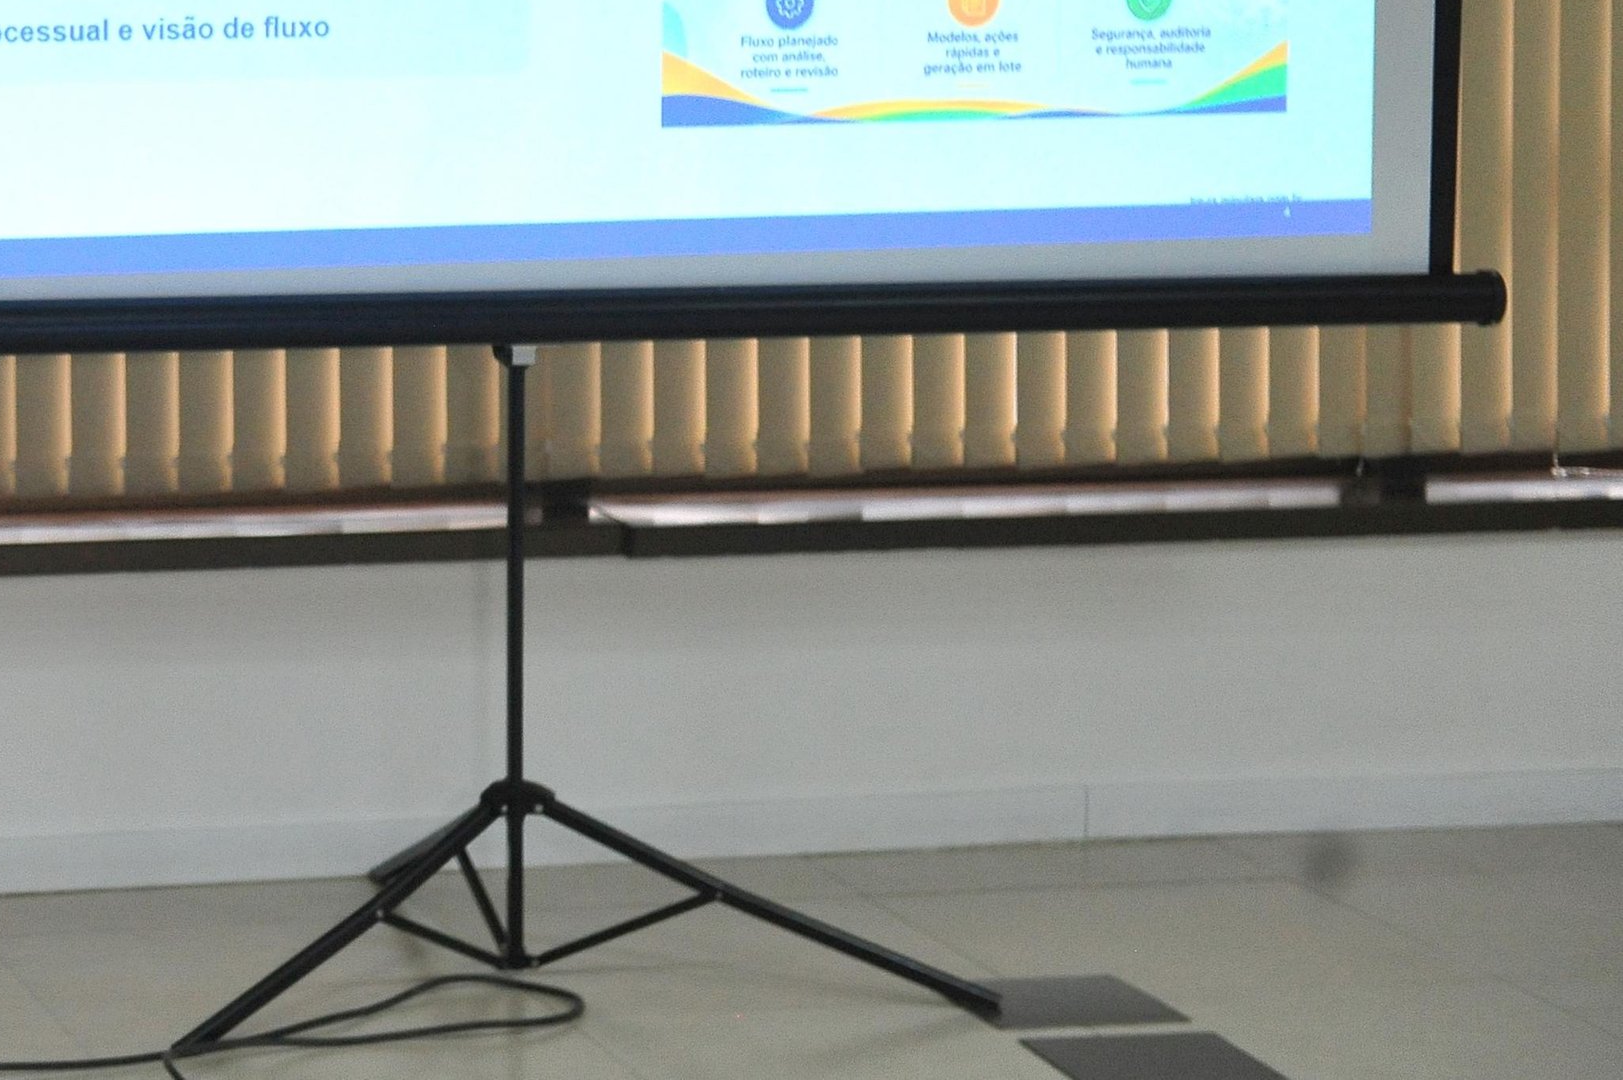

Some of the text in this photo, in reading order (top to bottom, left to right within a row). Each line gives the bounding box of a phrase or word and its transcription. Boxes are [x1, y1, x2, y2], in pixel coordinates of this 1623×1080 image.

[118, 23, 133, 42] e
[143, 16, 214, 42] visão
[223, 17, 255, 41] de
[263, 16, 330, 40] fluxo
